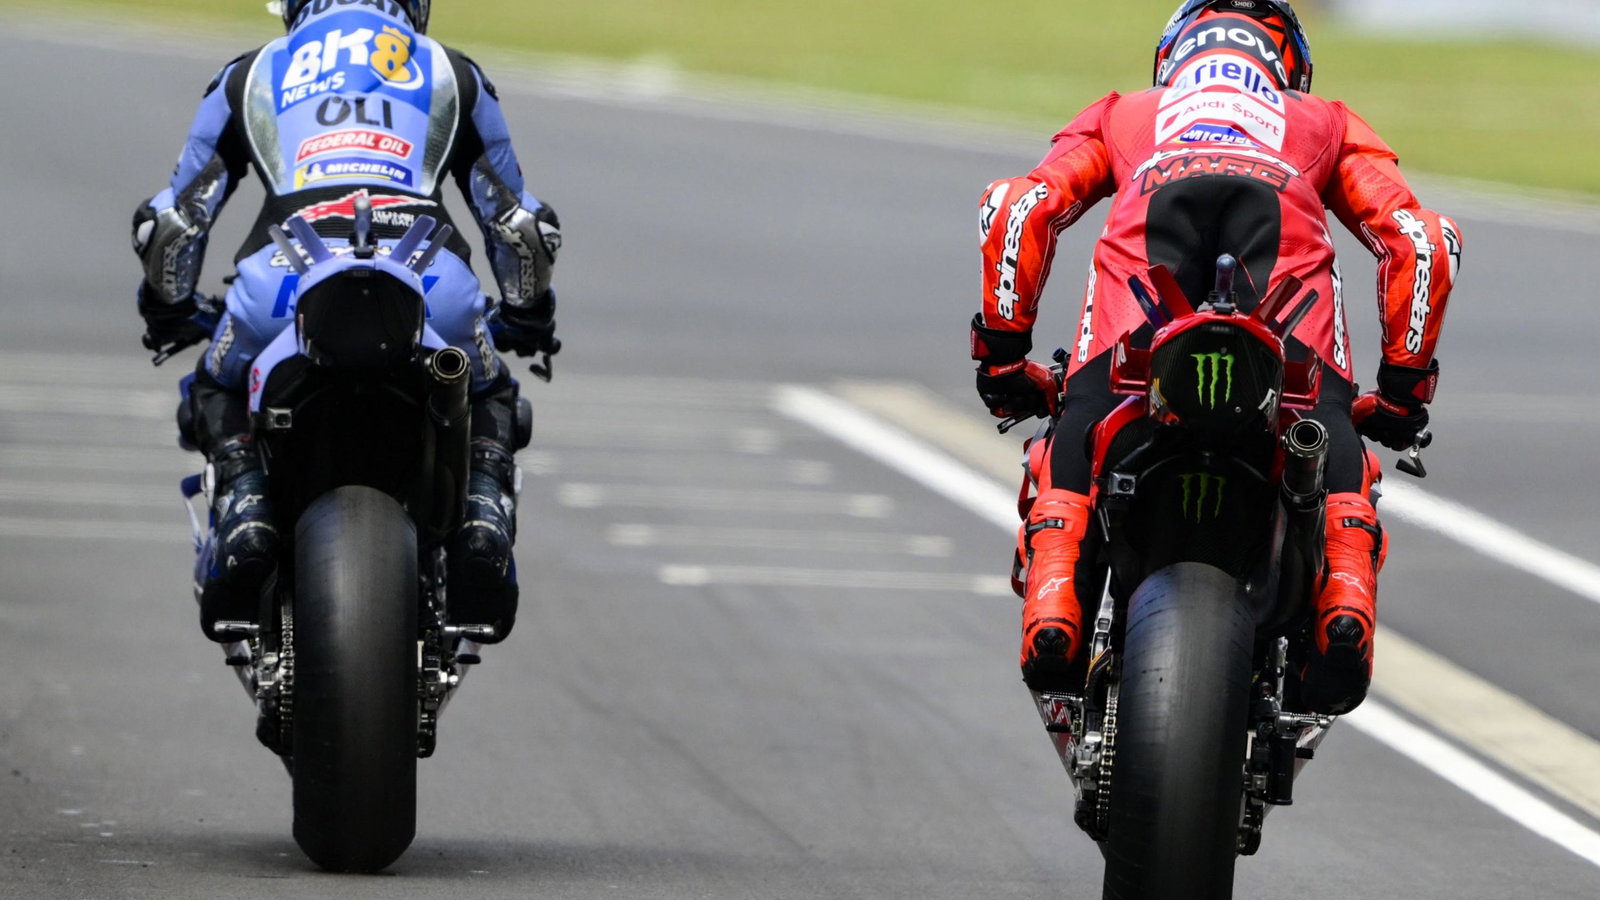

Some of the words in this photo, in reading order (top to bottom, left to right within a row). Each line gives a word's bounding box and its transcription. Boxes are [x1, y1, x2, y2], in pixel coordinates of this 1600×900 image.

[281, 26, 411, 90] BK8
[281, 72, 345, 108] NEWS
[1195, 60, 1279, 104] riello
[316, 96, 393, 130] OLI
[1183, 101, 1225, 116] Audi
[1232, 103, 1279, 136] Sport
[301, 133, 375, 156] FEDERAL
[379, 138, 404, 154] OIL
[326, 163, 406, 180] MICHELIN
[994, 182, 1049, 320] alpinestars
[1391, 208, 1437, 354] alpinestars
